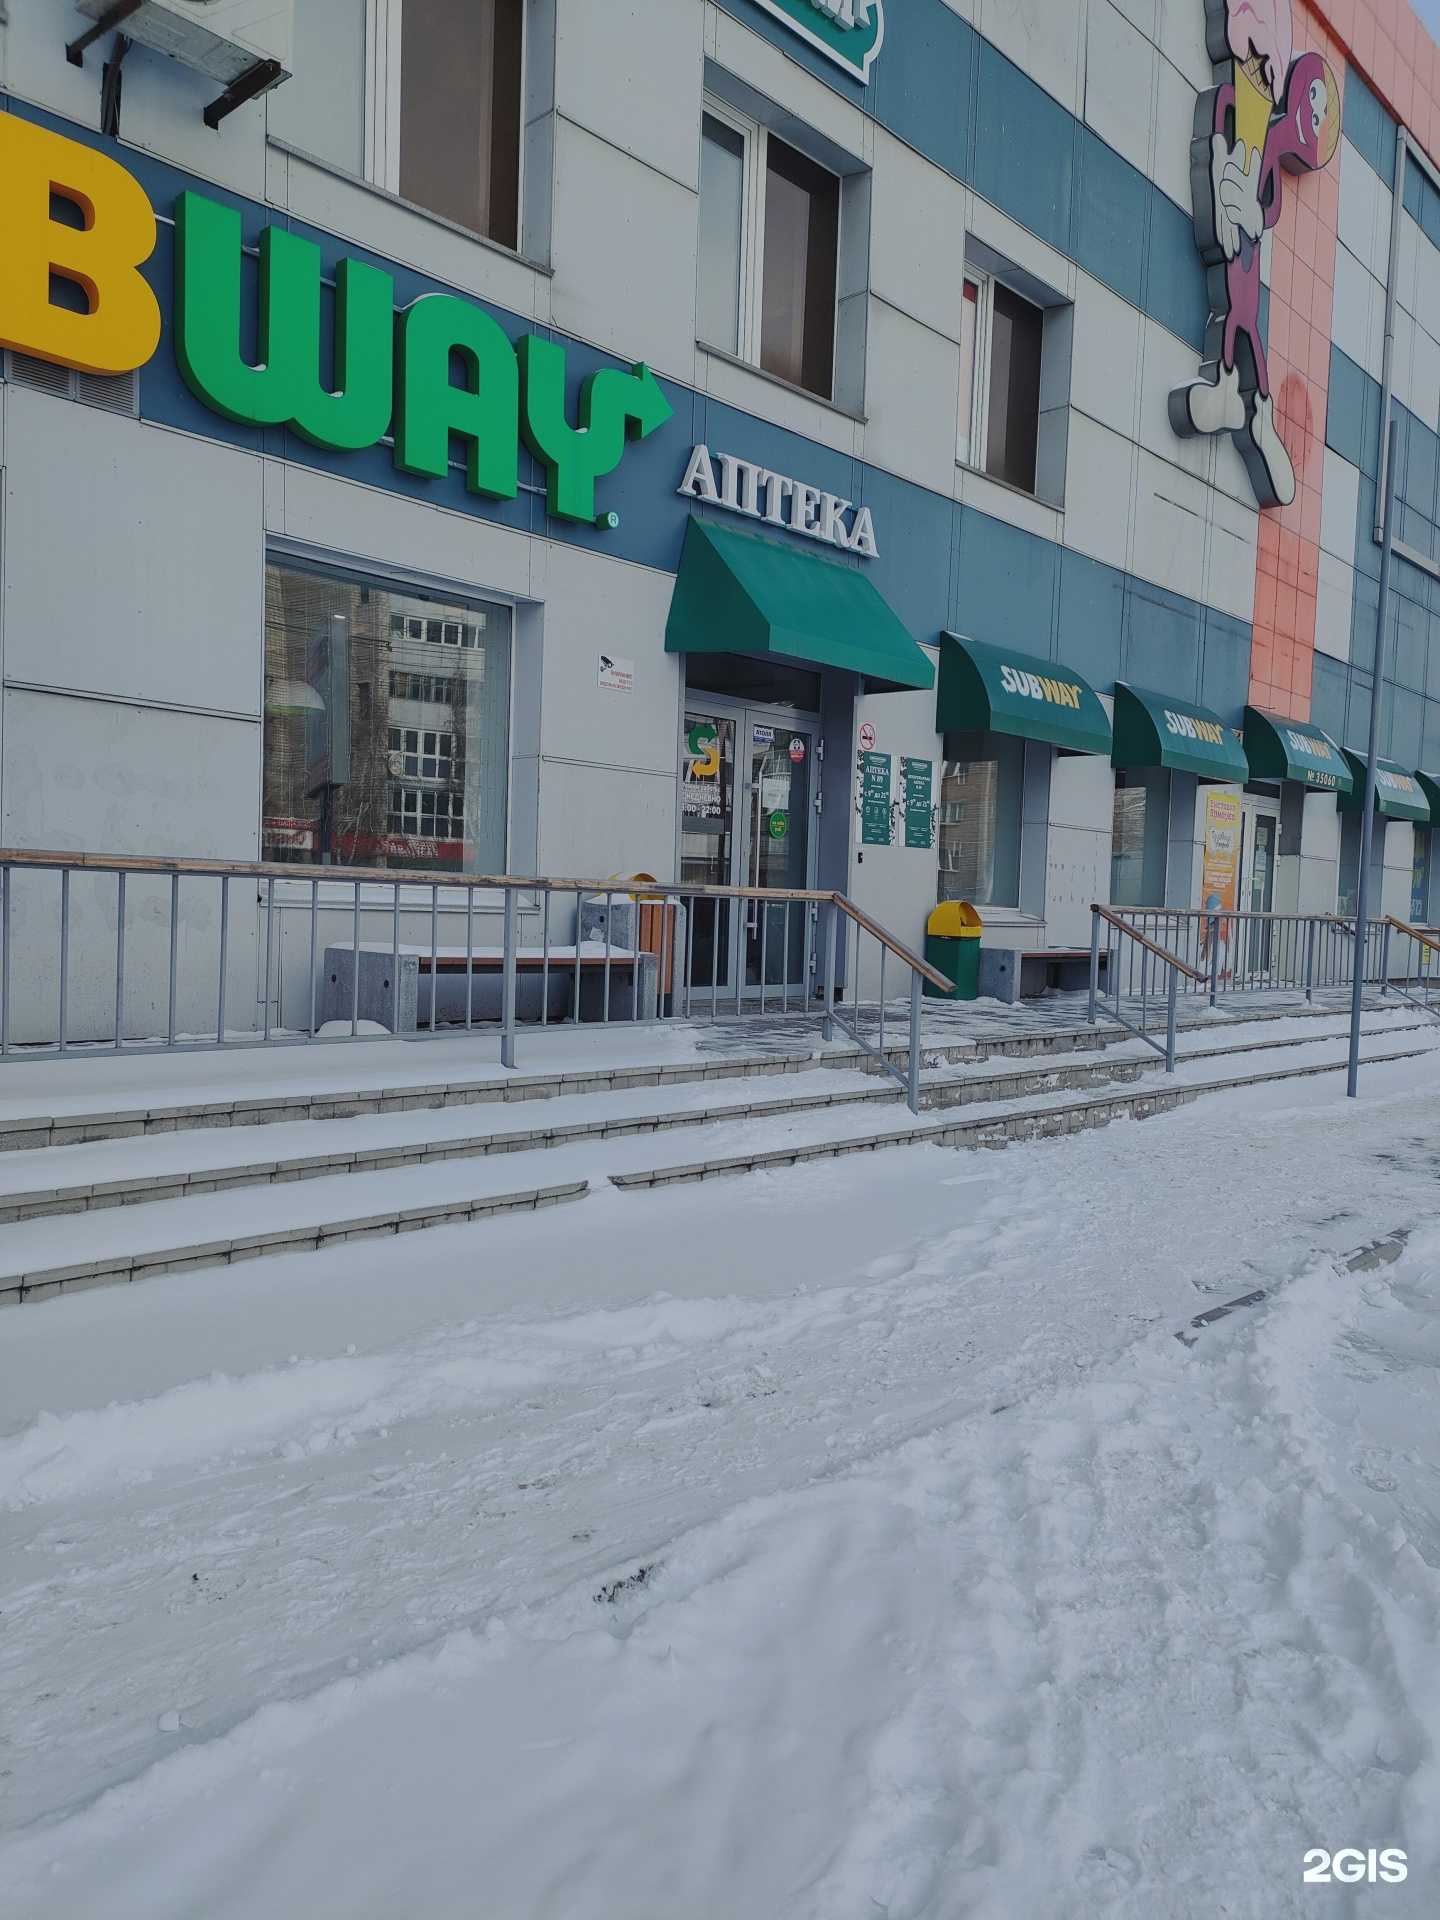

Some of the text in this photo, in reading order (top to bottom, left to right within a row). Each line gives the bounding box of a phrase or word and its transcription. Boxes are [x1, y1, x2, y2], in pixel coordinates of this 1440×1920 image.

[677, 443, 880, 559] АПТЕКА
[1000, 664, 1083, 710] SUBWAY
[1164, 709, 1224, 746] SUBWAY
[1316, 772, 1336, 787] 35060
[702, 805, 721, 815] 22:00
